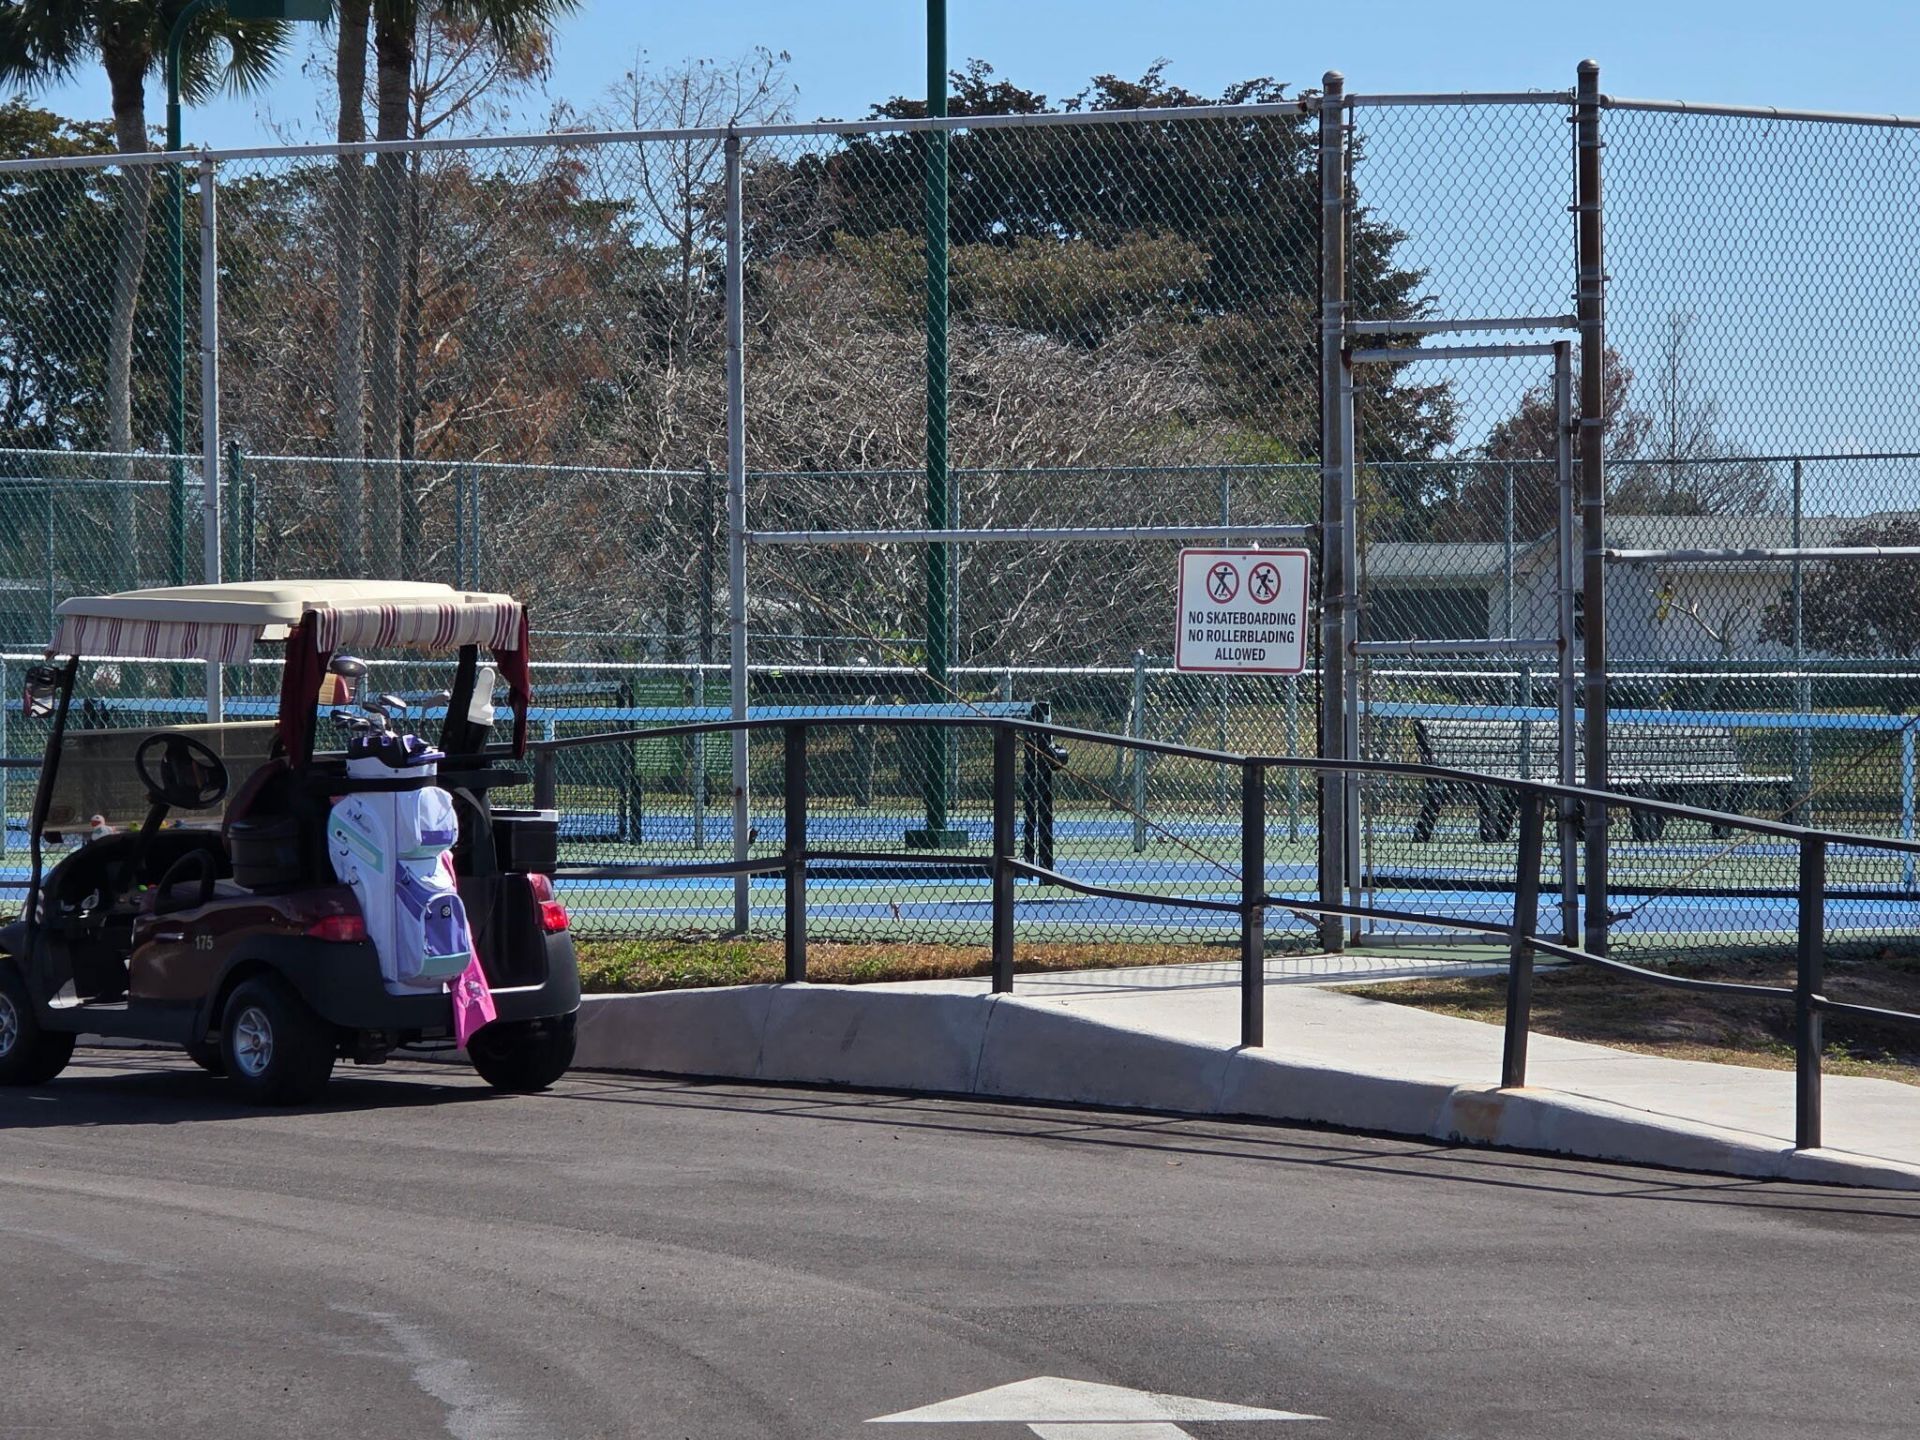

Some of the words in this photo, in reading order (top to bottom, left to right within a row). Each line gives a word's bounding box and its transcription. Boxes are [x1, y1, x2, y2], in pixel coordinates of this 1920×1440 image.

[1188, 611, 1204, 624] NO
[1206, 611, 1296, 626] SKATEBOARDING
[1188, 629, 1204, 642] NO
[1206, 630, 1295, 644] ROLLERBLADING
[1214, 647, 1266, 661] ALLOWED
[195, 935, 214, 951] 175
